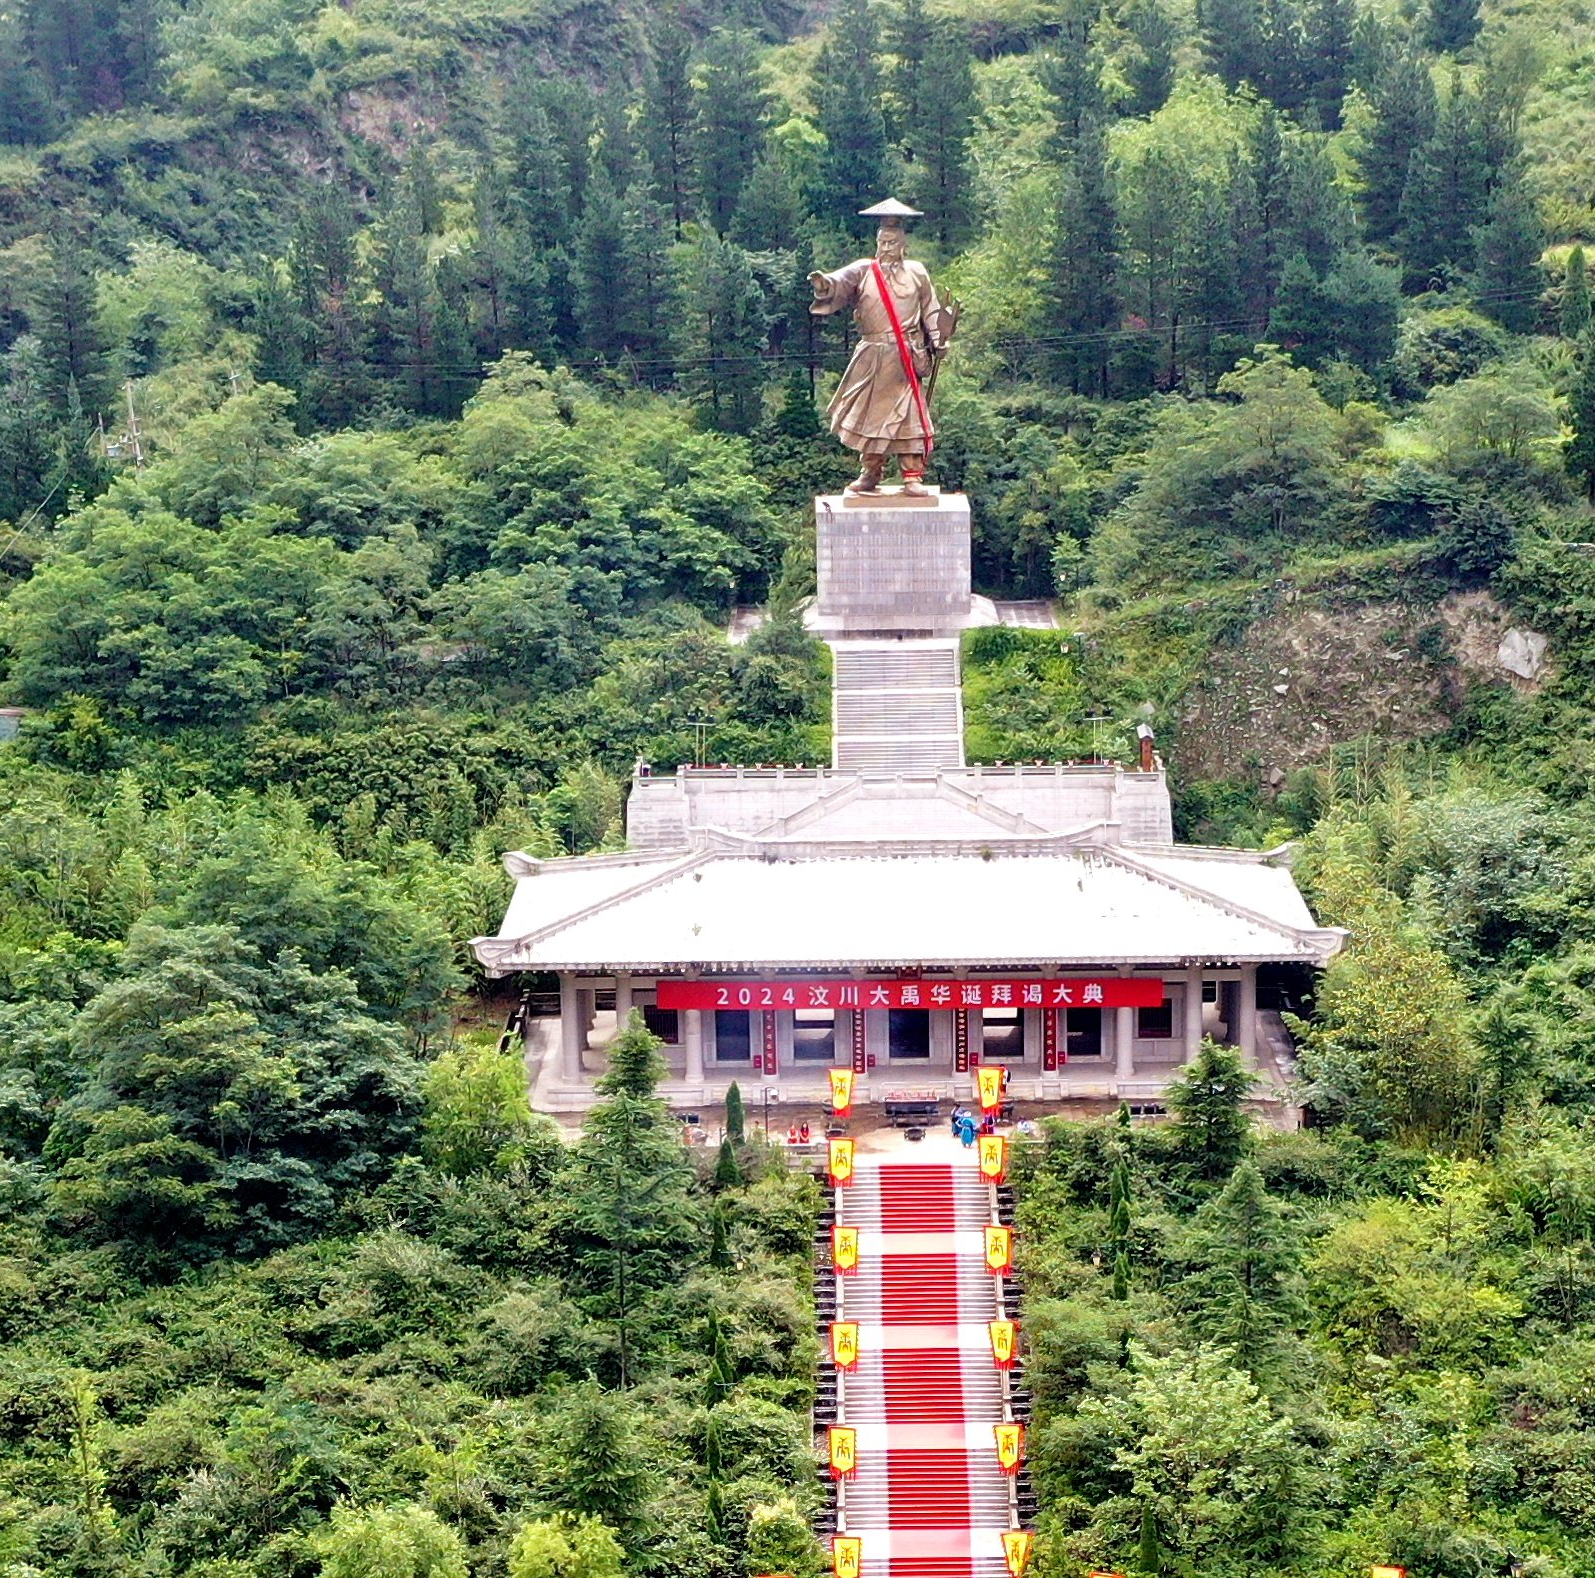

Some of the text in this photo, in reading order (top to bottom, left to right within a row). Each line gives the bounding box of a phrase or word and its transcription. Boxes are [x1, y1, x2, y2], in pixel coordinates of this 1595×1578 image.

[716, 983, 1103, 1006] 2024汶川大禹华诞拜谒大典
